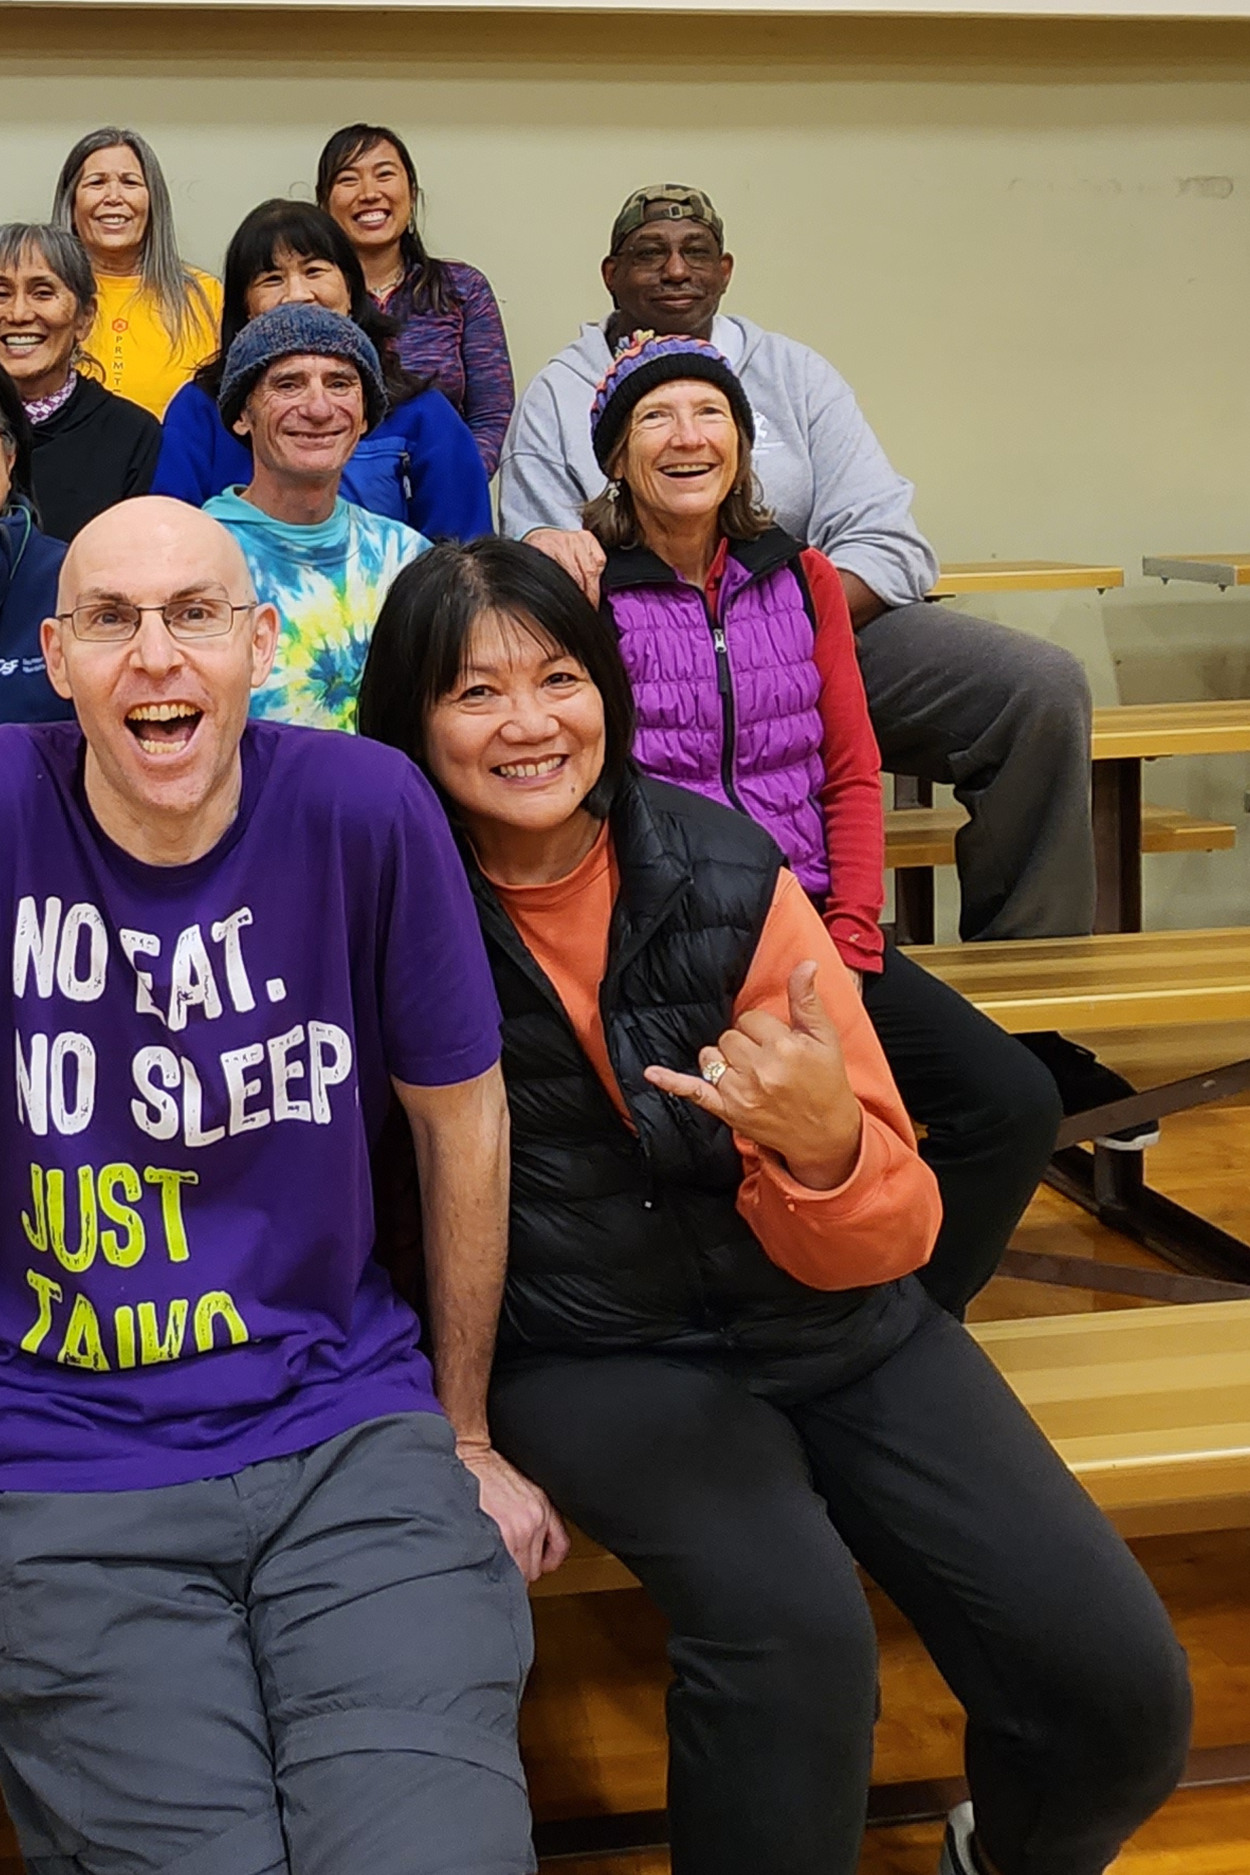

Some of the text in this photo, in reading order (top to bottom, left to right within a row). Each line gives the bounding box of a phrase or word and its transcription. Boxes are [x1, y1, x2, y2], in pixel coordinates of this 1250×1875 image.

[13, 896, 286, 1031] NO EAT.
[15, 1021, 351, 1146] NO SLEEP
[21, 1163, 198, 1273] JUST
